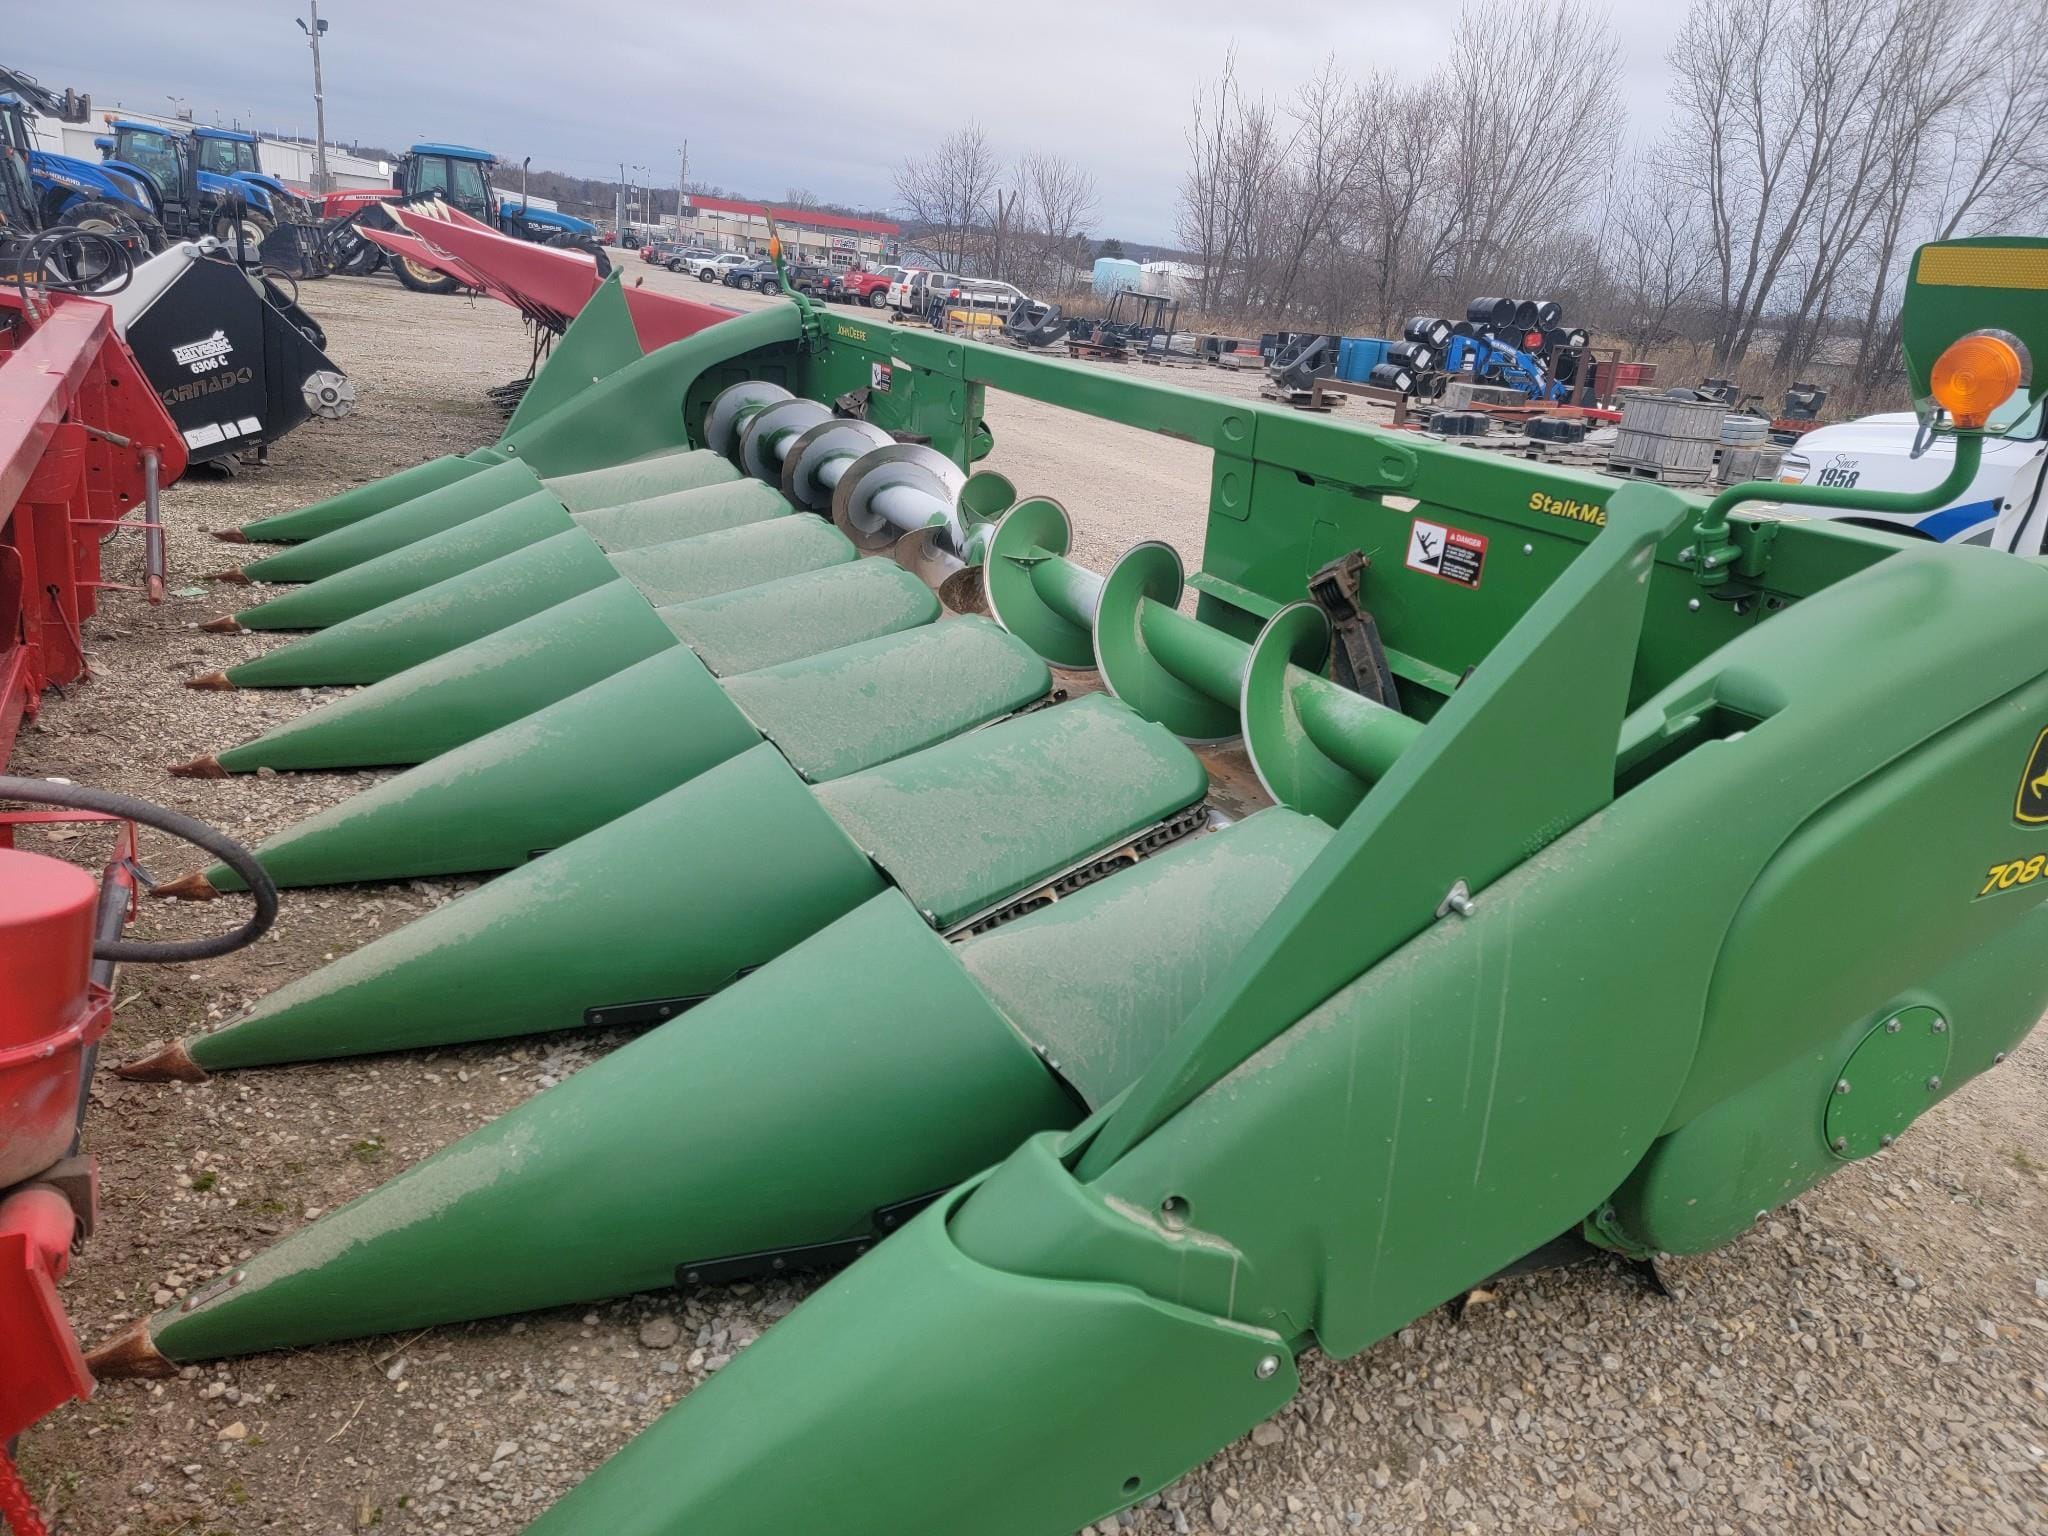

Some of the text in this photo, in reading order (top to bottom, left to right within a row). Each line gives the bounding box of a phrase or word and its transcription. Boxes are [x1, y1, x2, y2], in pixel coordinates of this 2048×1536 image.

[837, 323, 867, 341] JOHN DEERE
[191, 355, 229, 374] 6306 C
[159, 367, 253, 406] ORNADO
[1826, 453, 1859, 469] Since
[1816, 468, 1860, 489] 1958
[1456, 533, 1482, 547] DANGER
[1979, 854, 2048, 896] 708
